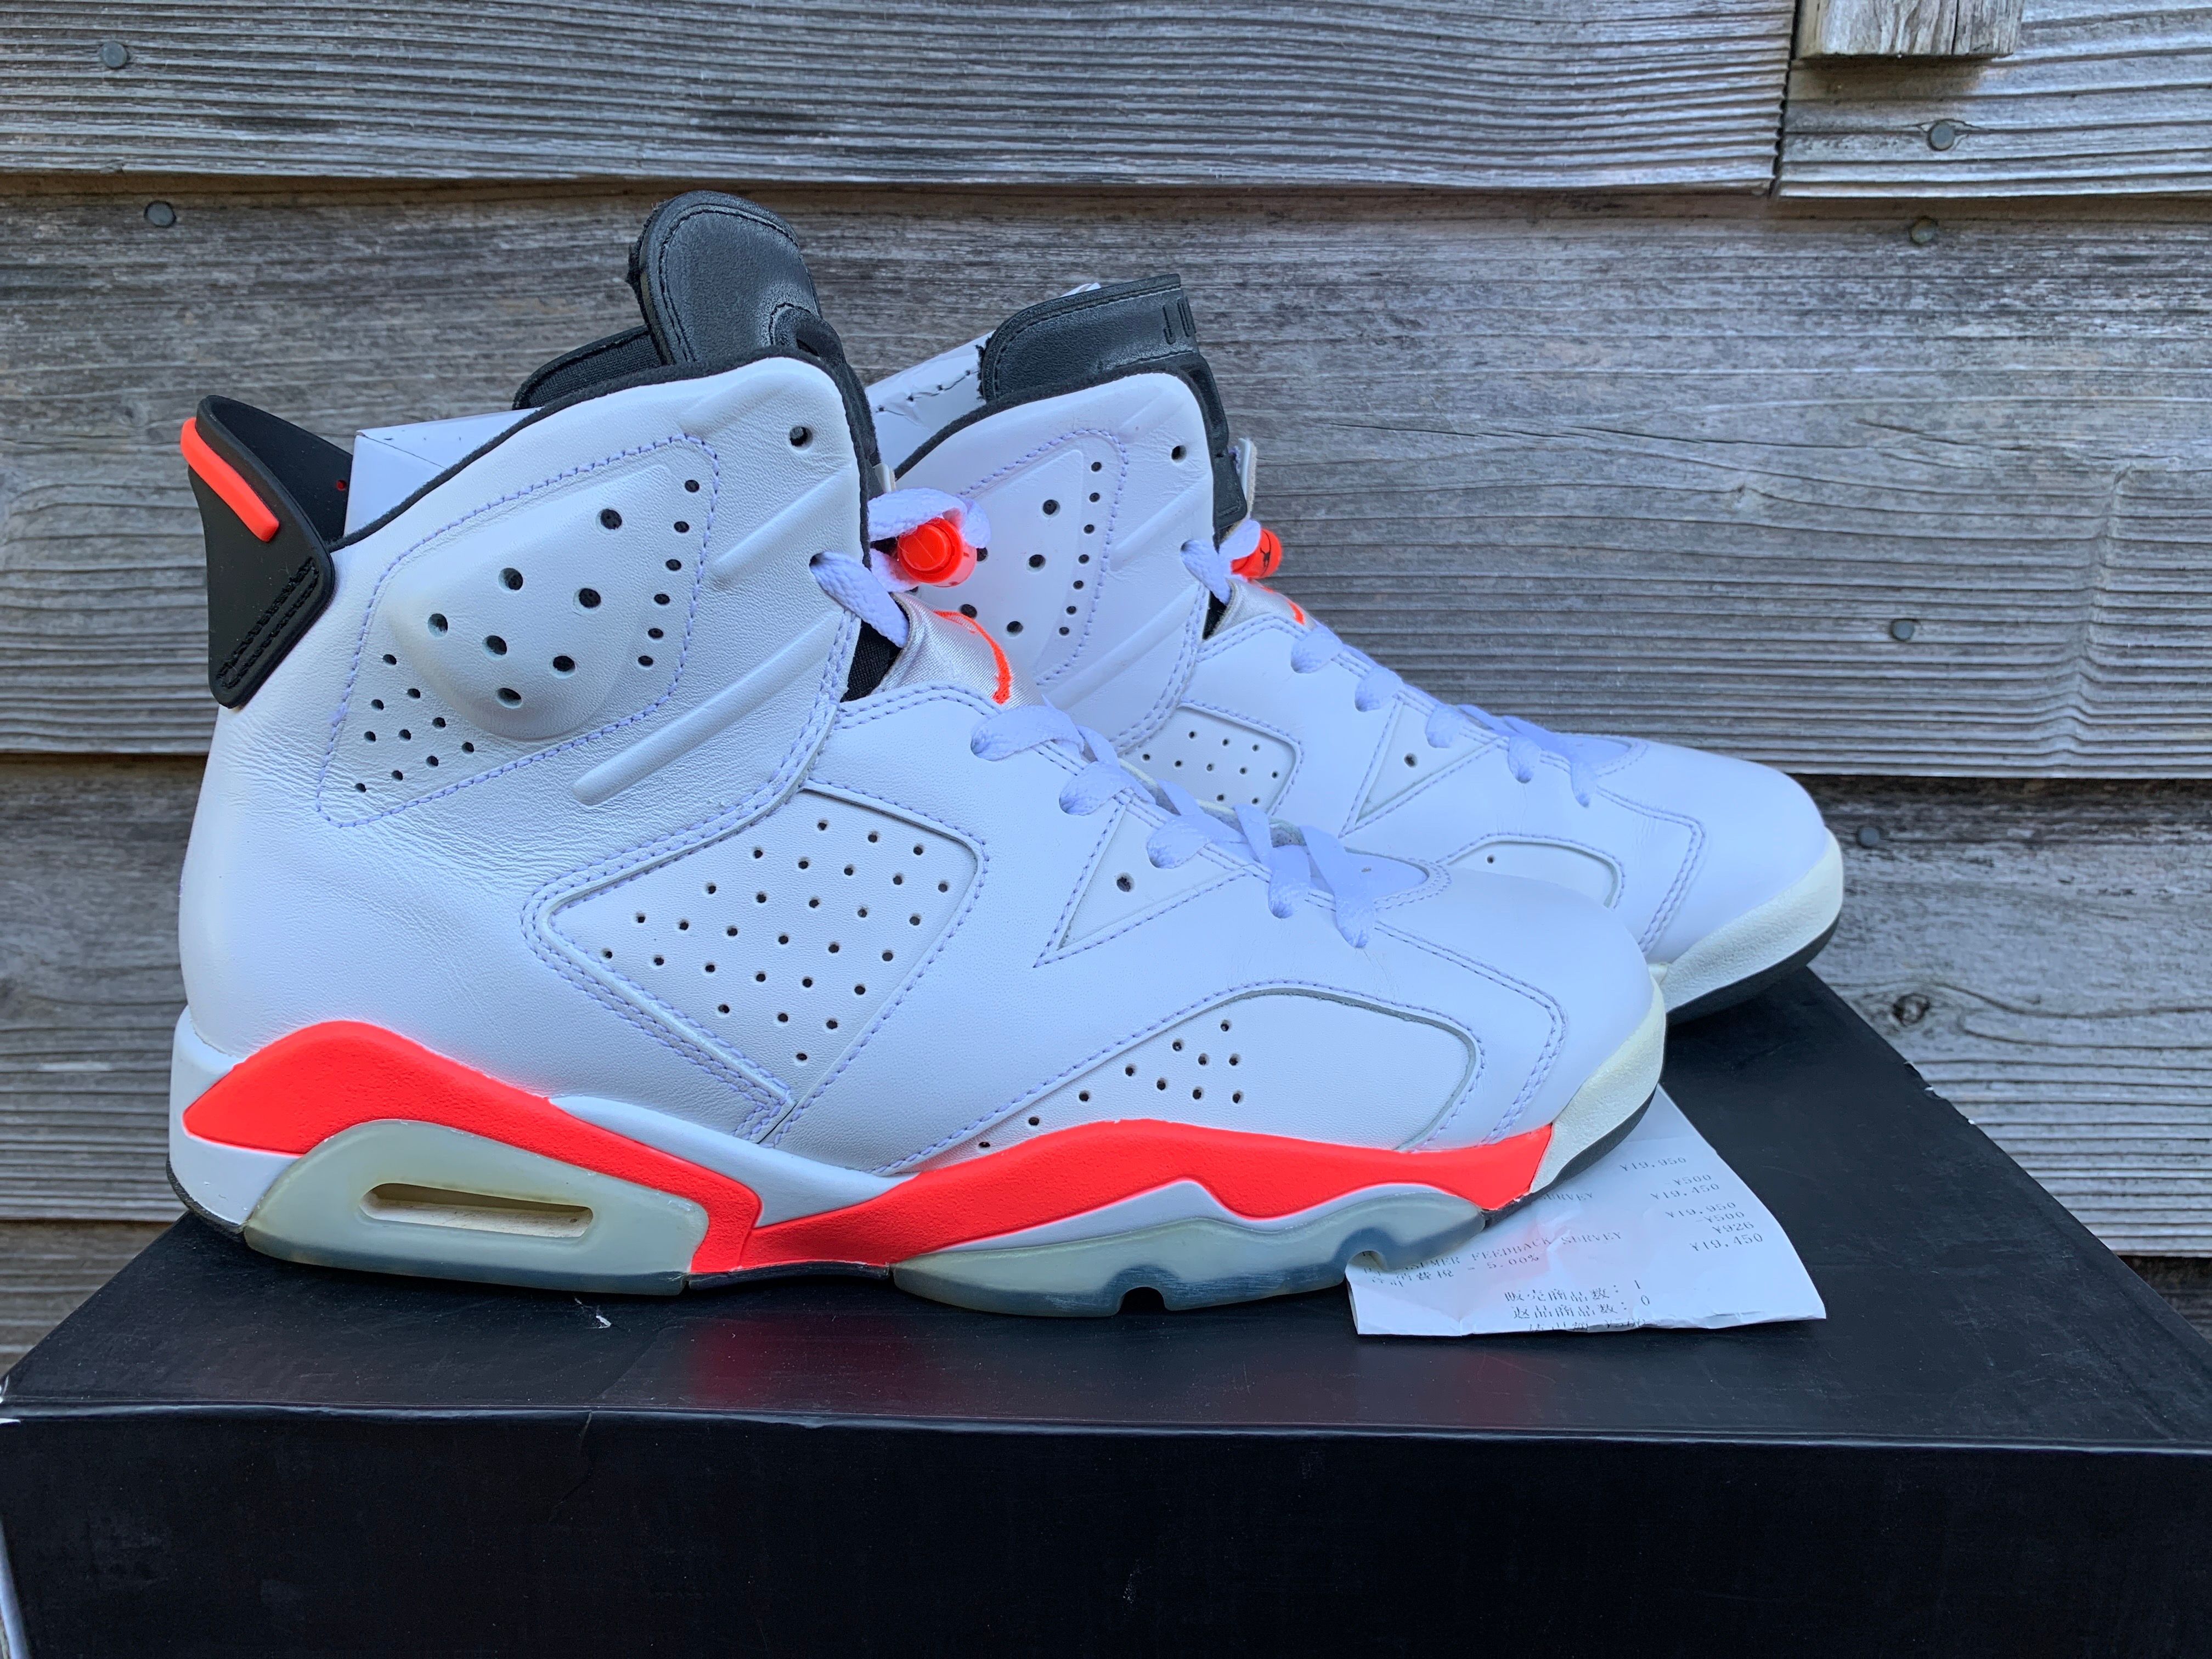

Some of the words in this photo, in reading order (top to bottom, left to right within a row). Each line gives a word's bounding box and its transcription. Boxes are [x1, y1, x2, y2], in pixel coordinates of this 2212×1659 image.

[1712, 1221, 1754, 1234] ¥926
[1471, 1237, 1551, 1261] FEEDBACK
[1562, 1232, 1622, 1244] SURVEY
